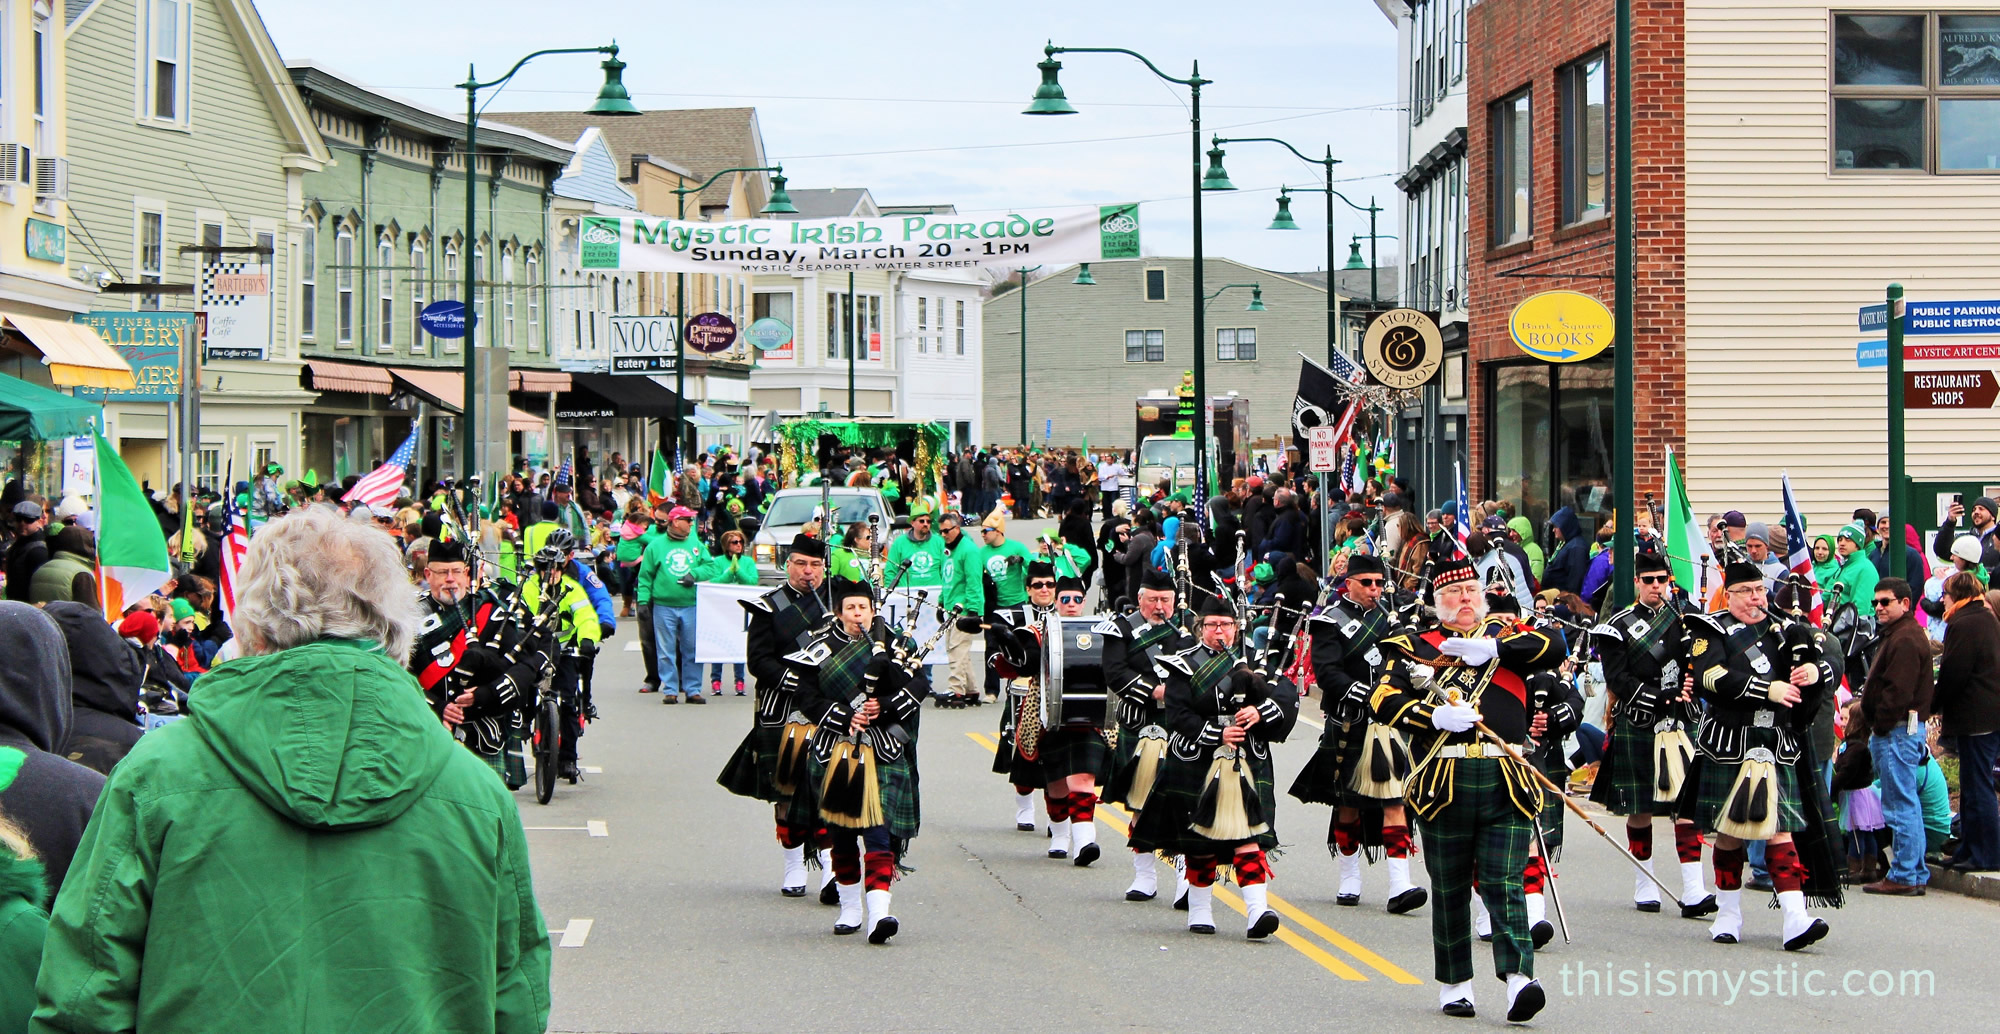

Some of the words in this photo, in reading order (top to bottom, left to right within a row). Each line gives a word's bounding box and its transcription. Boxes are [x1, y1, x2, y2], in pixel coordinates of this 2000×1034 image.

[1943, 34, 1977, 42] ALFRED
[633, 218, 770, 252] Mystic
[791, 221, 882, 244] Irish
[903, 214, 1054, 241] Parade
[691, 246, 806, 264] Sunday,
[819, 244, 904, 261] March
[918, 243, 951, 257] 20
[983, 241, 1029, 255] 1PM
[797, 263, 859, 272] SEAPORT
[874, 261, 921, 269] WATER
[928, 260, 980, 268] STREET
[217, 278, 265, 292] BARTLEBY'S
[1877, 311, 1887, 324] RIVE
[1913, 307, 1951, 316] PUBLIC
[82, 317, 107, 326] THE
[113, 318, 151, 326] FINER
[158, 318, 187, 327] LINE
[1380, 312, 1425, 328] HOPE
[1562, 322, 1603, 330] Square
[1913, 319, 1951, 328] PUBLIC
[613, 320, 677, 353] NOCA
[1529, 332, 1594, 345] BOOKS
[1385, 331, 1419, 367] &
[1914, 348, 1951, 357] MYSTIC
[1953, 347, 1973, 357] ART
[617, 359, 648, 370] eatery
[660, 357, 677, 368] bar
[1369, 358, 1436, 386] STETSON
[1914, 374, 1981, 389] RESTAURANTS
[1932, 391, 1964, 405] SHOPS
[1316, 431, 1327, 439] NO
[1311, 441, 1333, 449] PARKING
